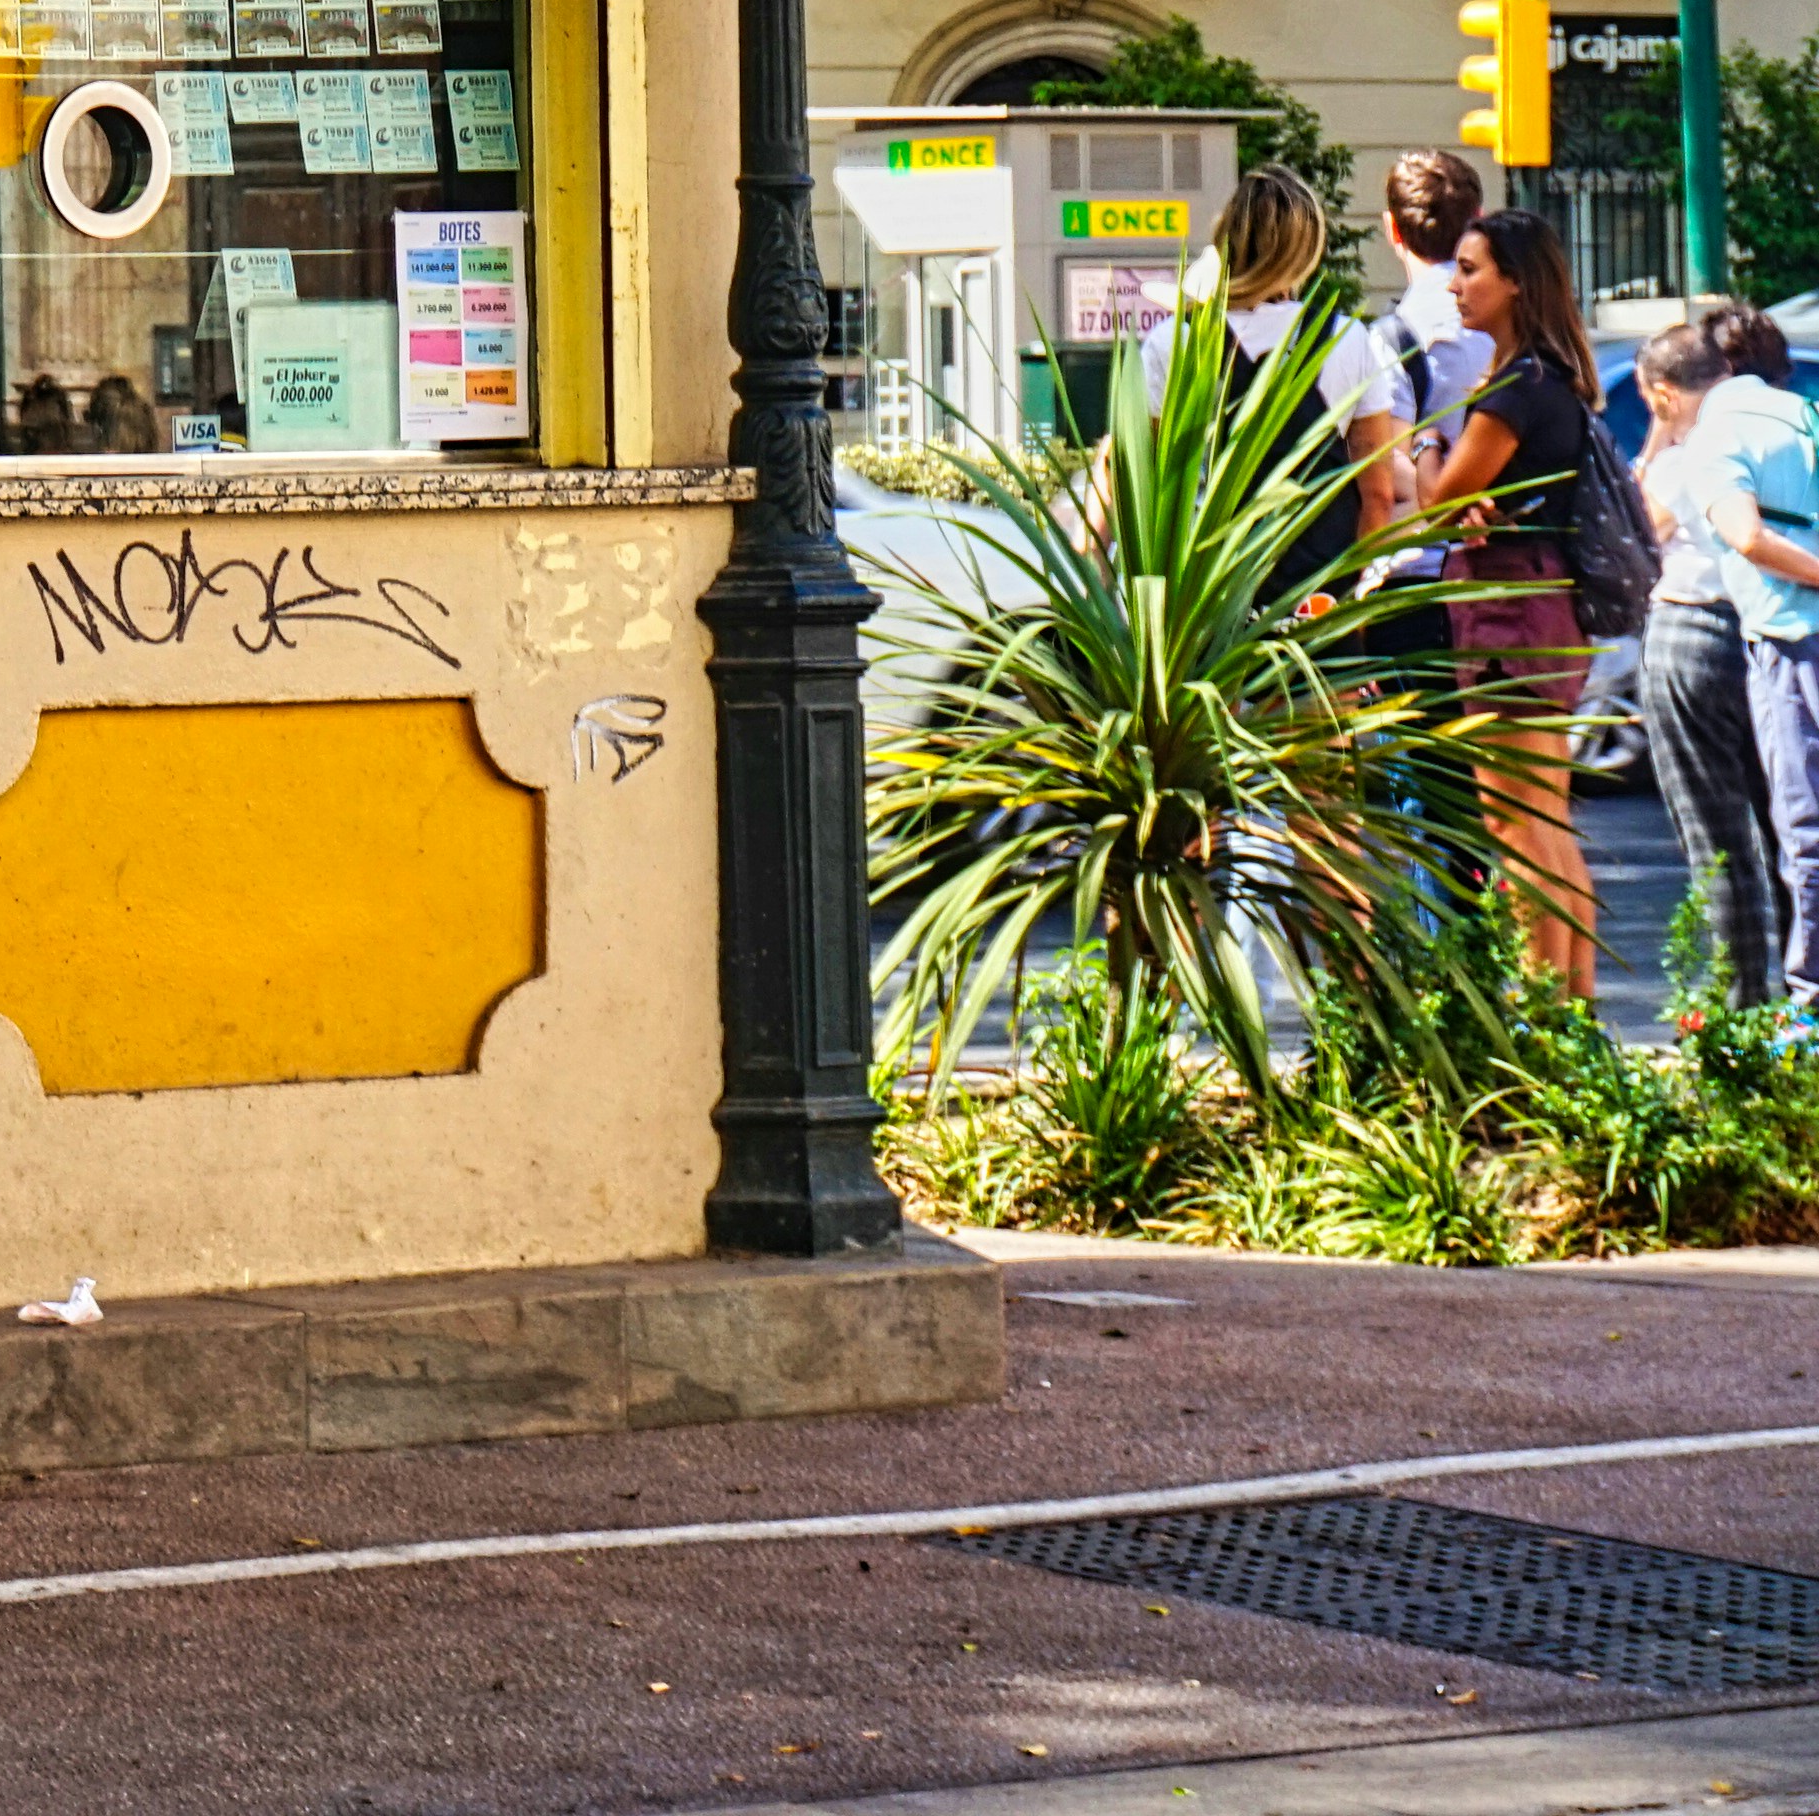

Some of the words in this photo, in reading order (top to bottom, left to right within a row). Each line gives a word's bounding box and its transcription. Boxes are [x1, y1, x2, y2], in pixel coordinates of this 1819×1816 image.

[1568, 22, 1681, 74] cajam
[922, 141, 986, 167] ONCE
[1101, 206, 1178, 232] ONCE
[438, 221, 482, 242] BOTES
[269, 385, 334, 403] 1.000.000
[180, 422, 217, 439] VISA
